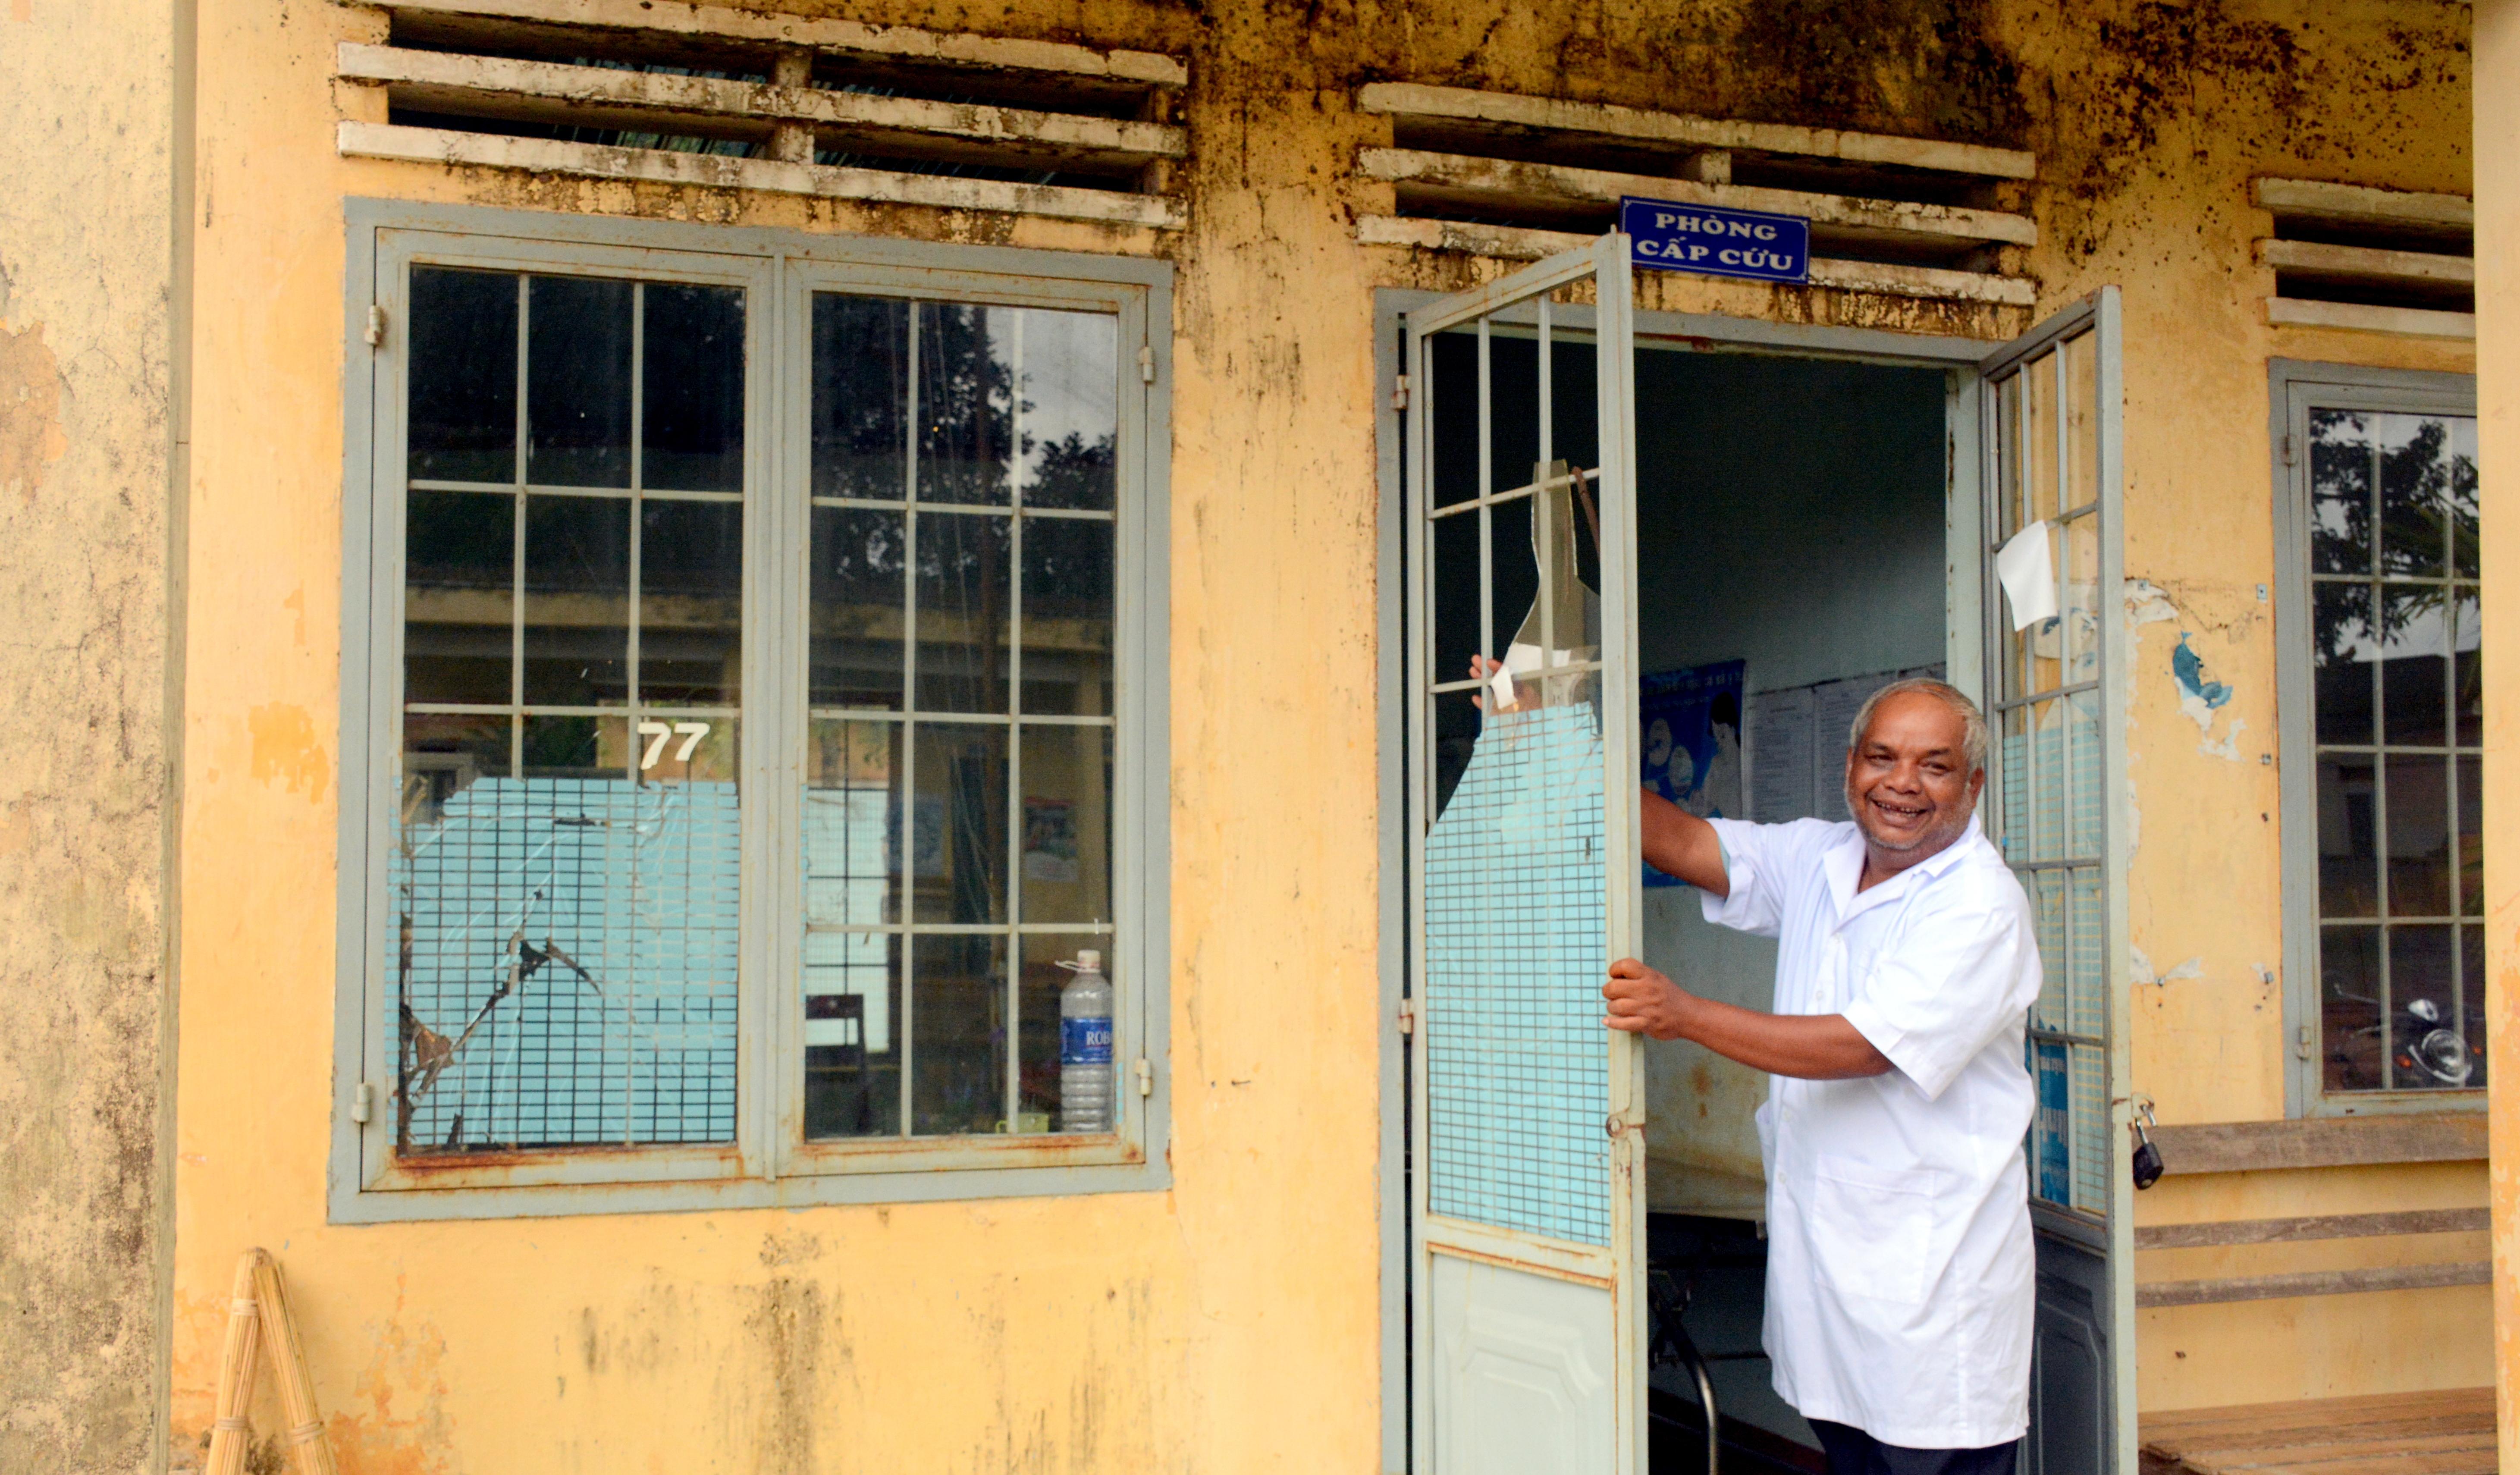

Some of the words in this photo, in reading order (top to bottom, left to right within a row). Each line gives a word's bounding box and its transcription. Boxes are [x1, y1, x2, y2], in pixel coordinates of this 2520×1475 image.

[1655, 213, 1777, 240] PHÒNG
[1637, 236, 1710, 261] CẤP
[1718, 247, 1793, 270] CỨU
[637, 722, 710, 770] 77
